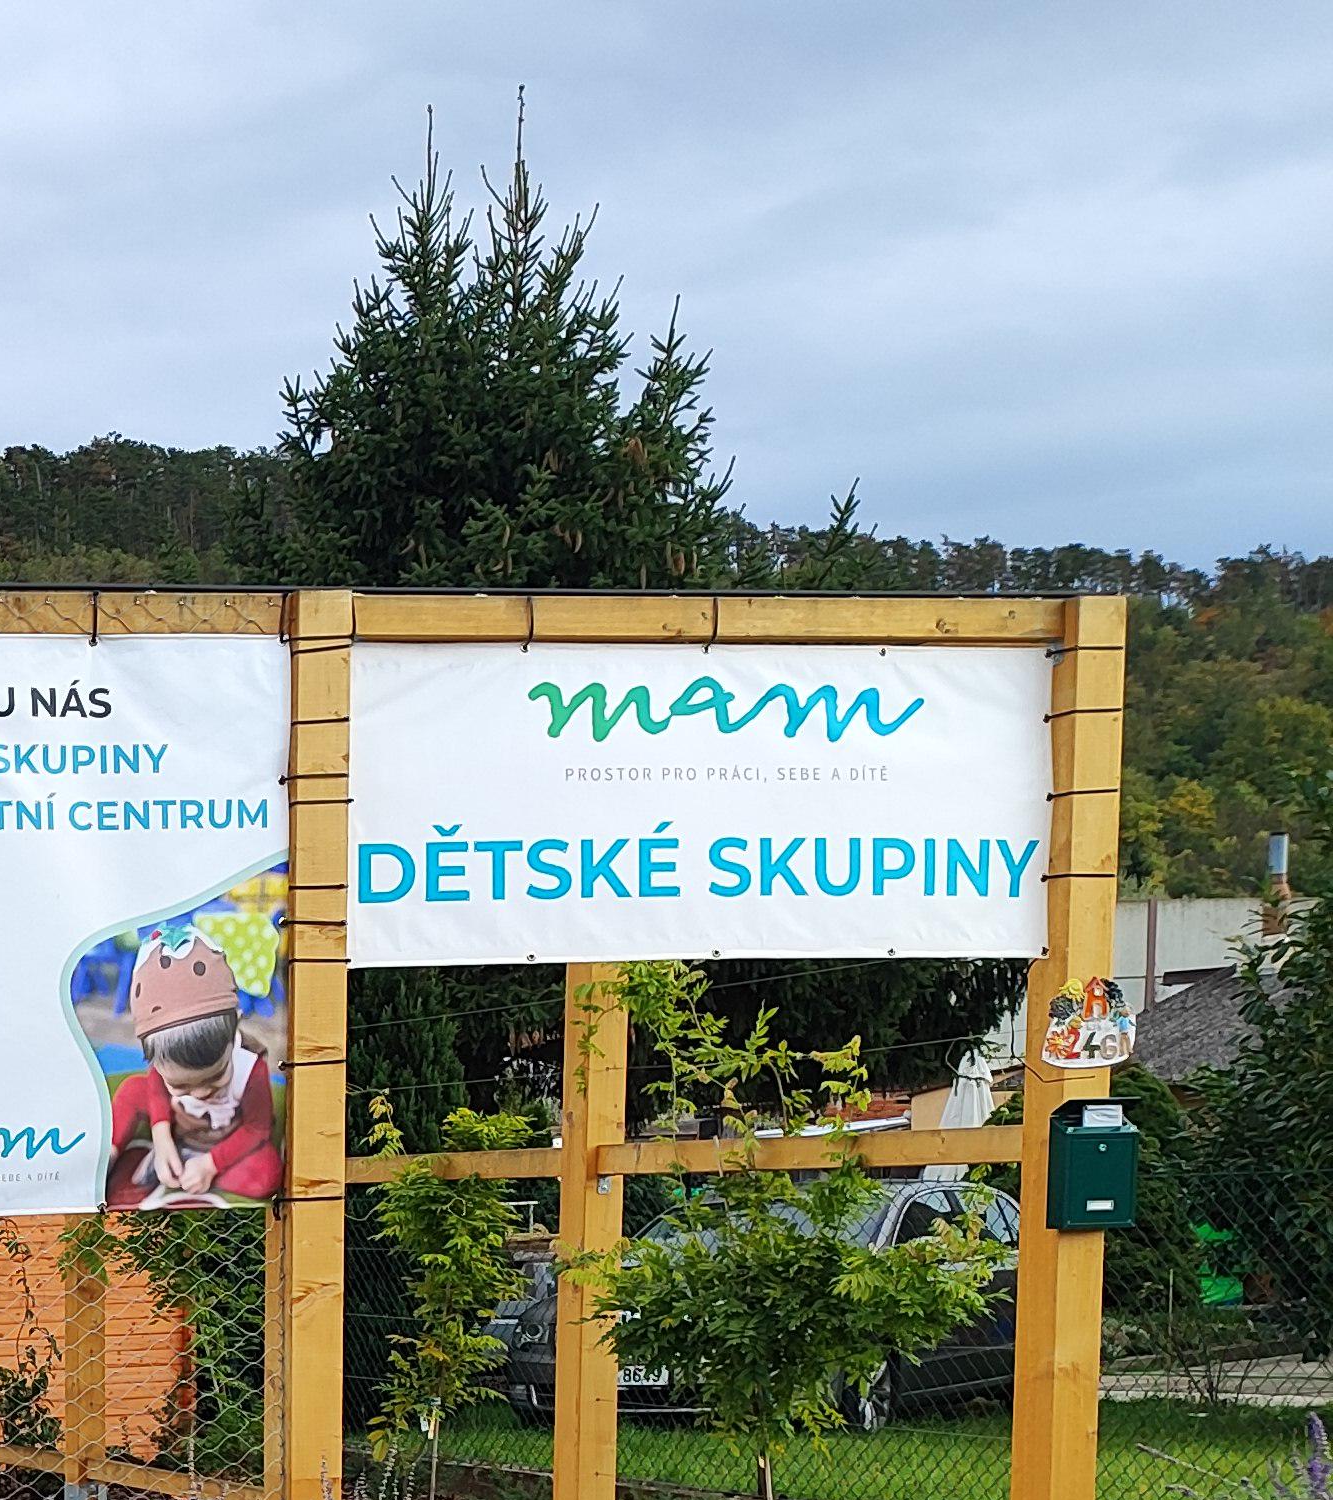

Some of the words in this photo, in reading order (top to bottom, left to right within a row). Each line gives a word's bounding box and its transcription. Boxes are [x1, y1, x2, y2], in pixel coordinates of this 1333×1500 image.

[31, 680, 112, 718] NÁS
[528, 675, 924, 742] mam
[565, 767, 652, 782] PROSTOR
[661, 767, 697, 781] PRO
[707, 765, 768, 783] PRÁCI,
[777, 767, 821, 781] SEBE
[832, 766, 841, 780] A
[850, 765, 889, 781] DÍTĚ
[68, 799, 268, 831] CENTRUM
[358, 821, 681, 904] DĚTSKÉ
[708, 837, 1040, 898] SKUPINY
